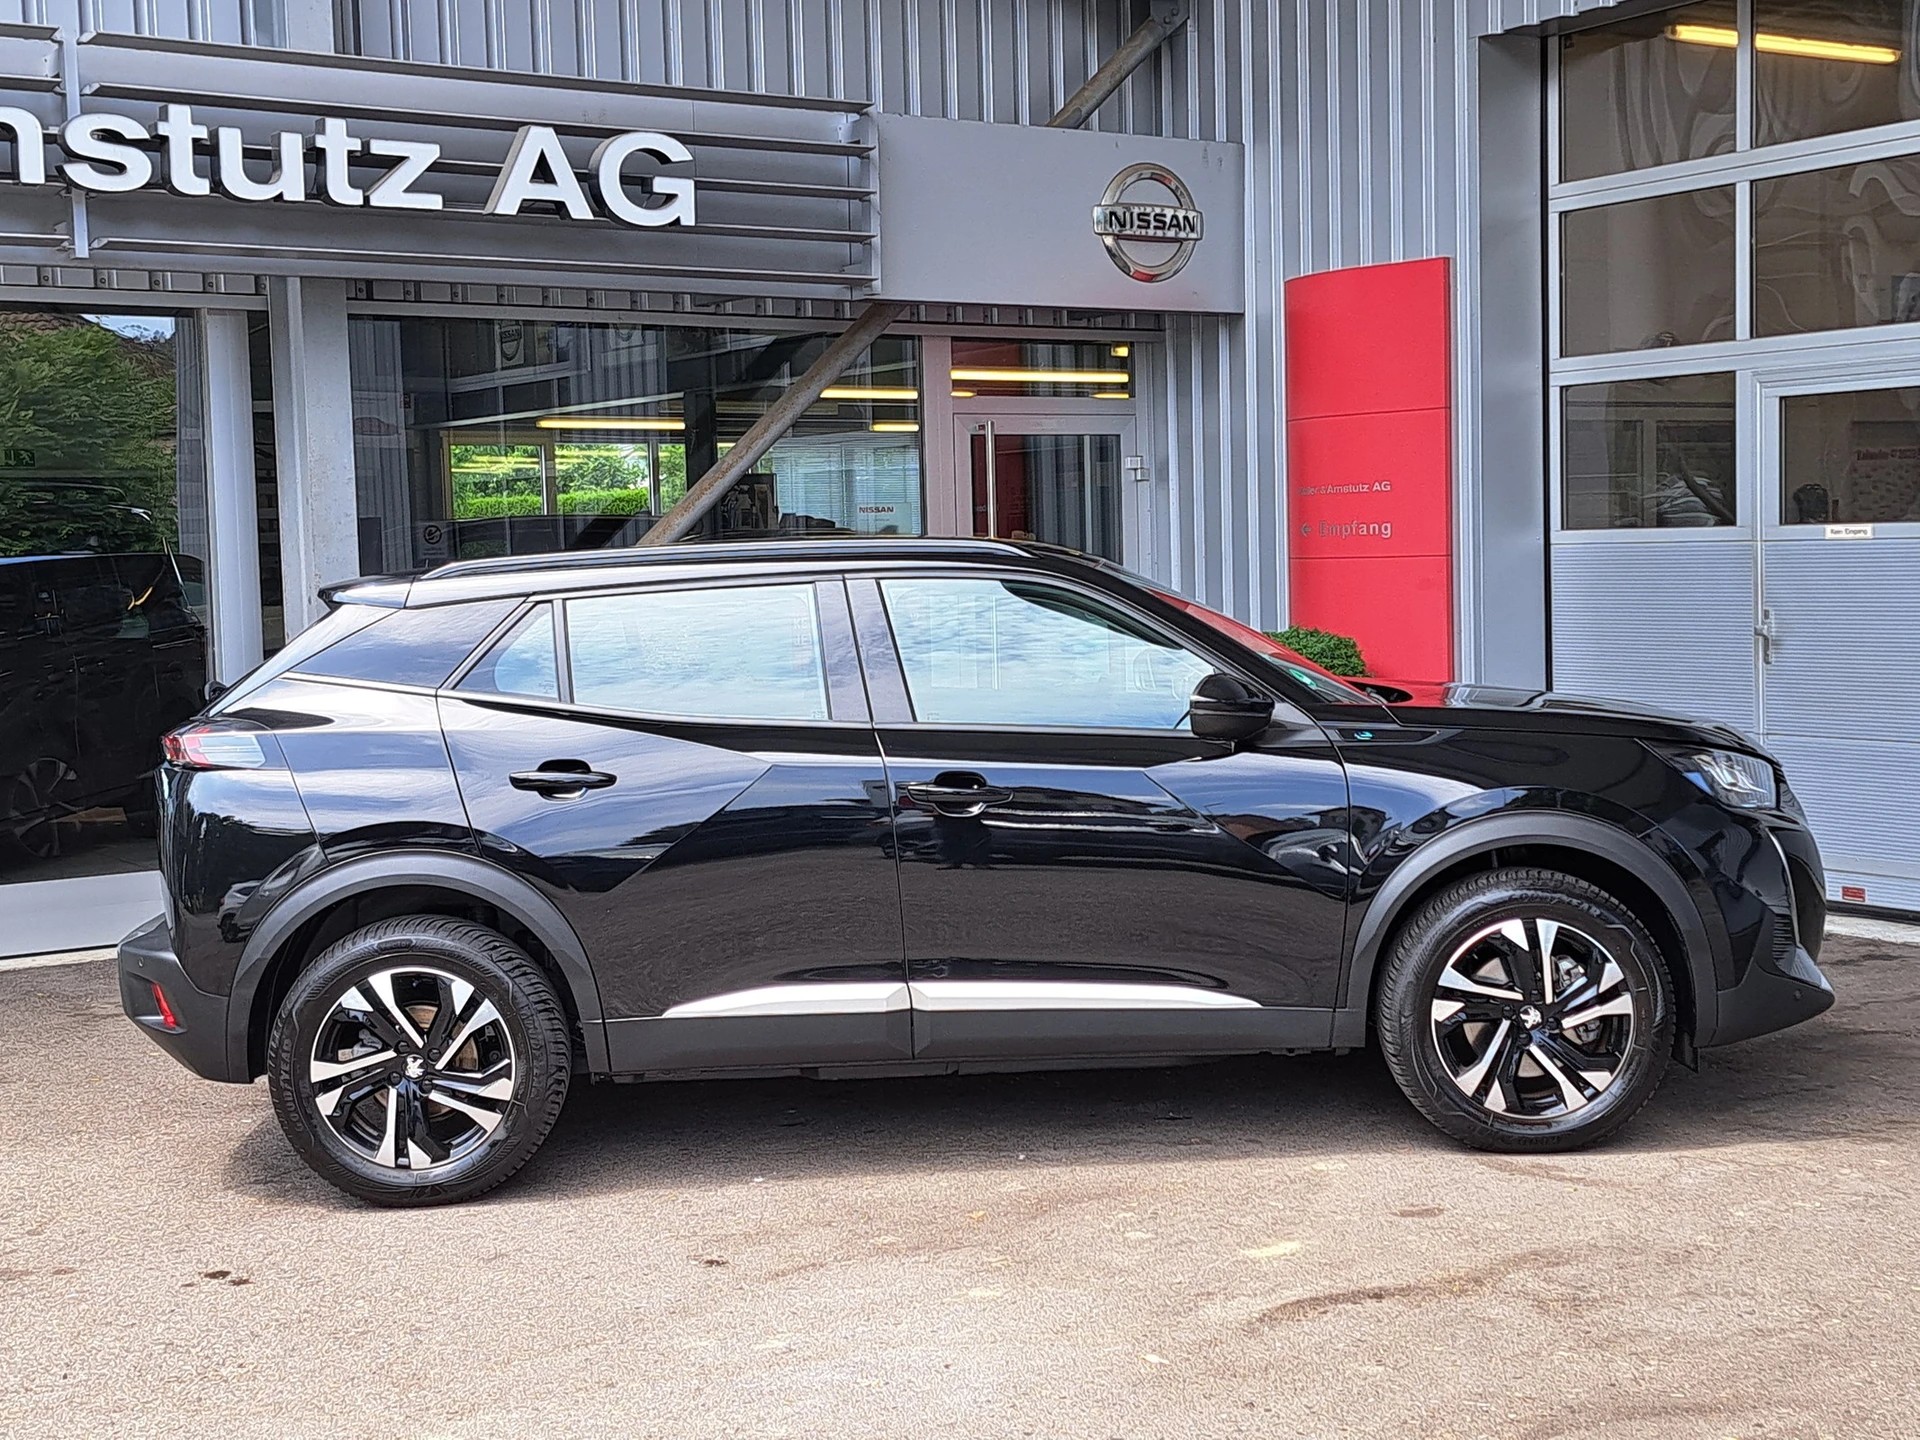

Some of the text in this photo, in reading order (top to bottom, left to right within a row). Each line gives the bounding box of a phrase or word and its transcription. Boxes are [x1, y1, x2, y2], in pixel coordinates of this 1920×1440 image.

[486, 125, 697, 227] AG
[1108, 210, 1197, 233] NISSAN
[1326, 483, 1370, 495] Amstutz
[1372, 480, 1392, 492] AG
[858, 506, 895, 514] NISSAN
[1319, 520, 1393, 539] Empfang
